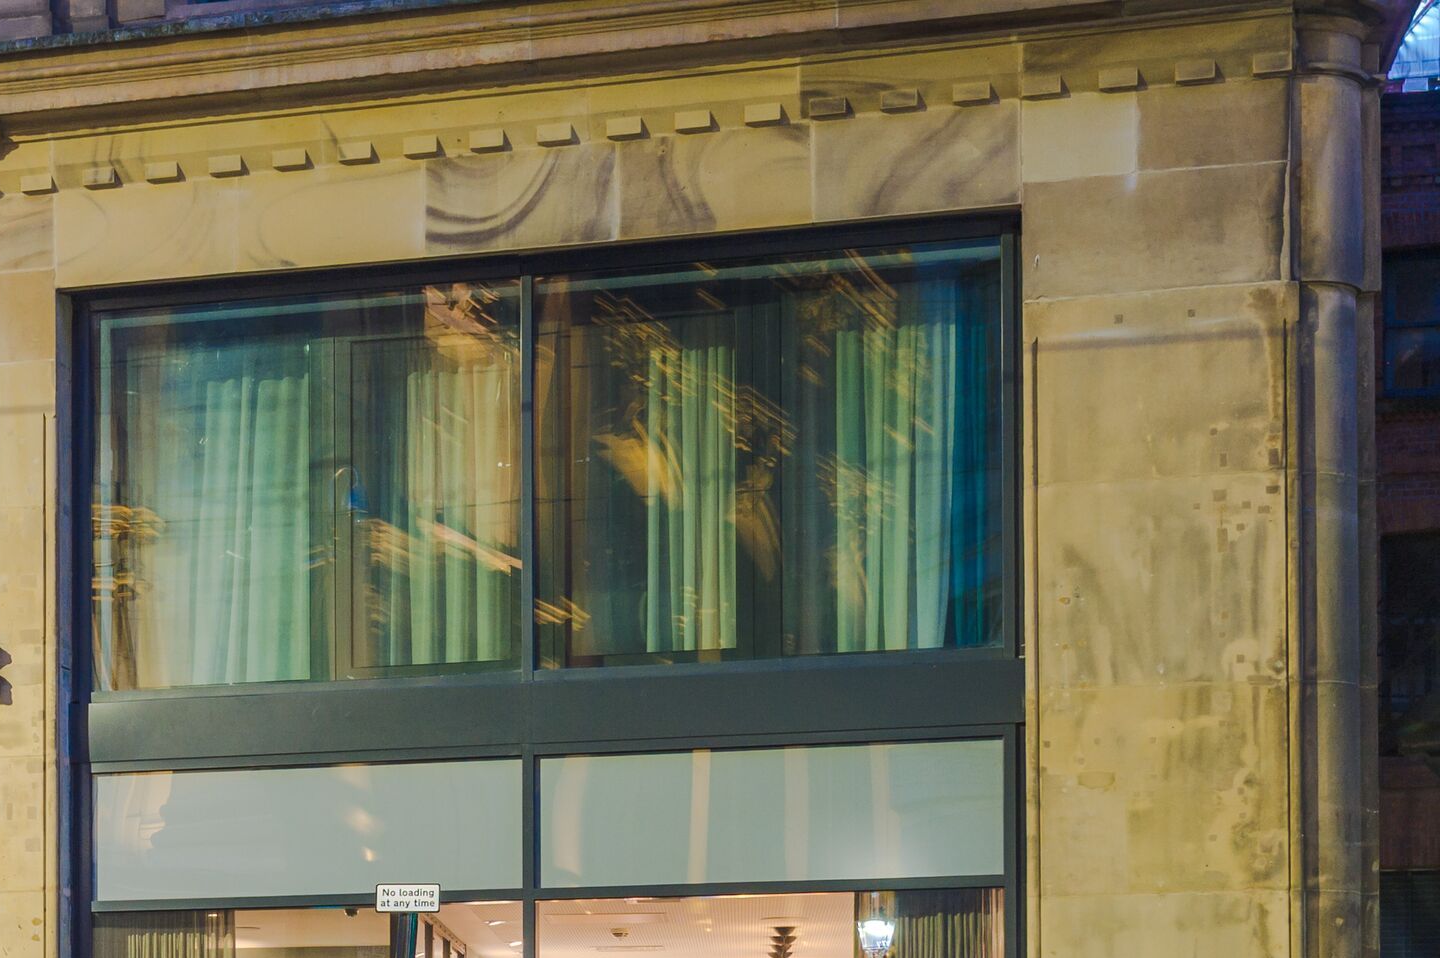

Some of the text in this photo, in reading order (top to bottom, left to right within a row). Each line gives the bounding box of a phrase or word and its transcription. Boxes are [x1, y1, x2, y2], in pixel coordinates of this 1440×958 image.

[382, 889, 435, 898] No loading
[414, 899, 435, 907] time
